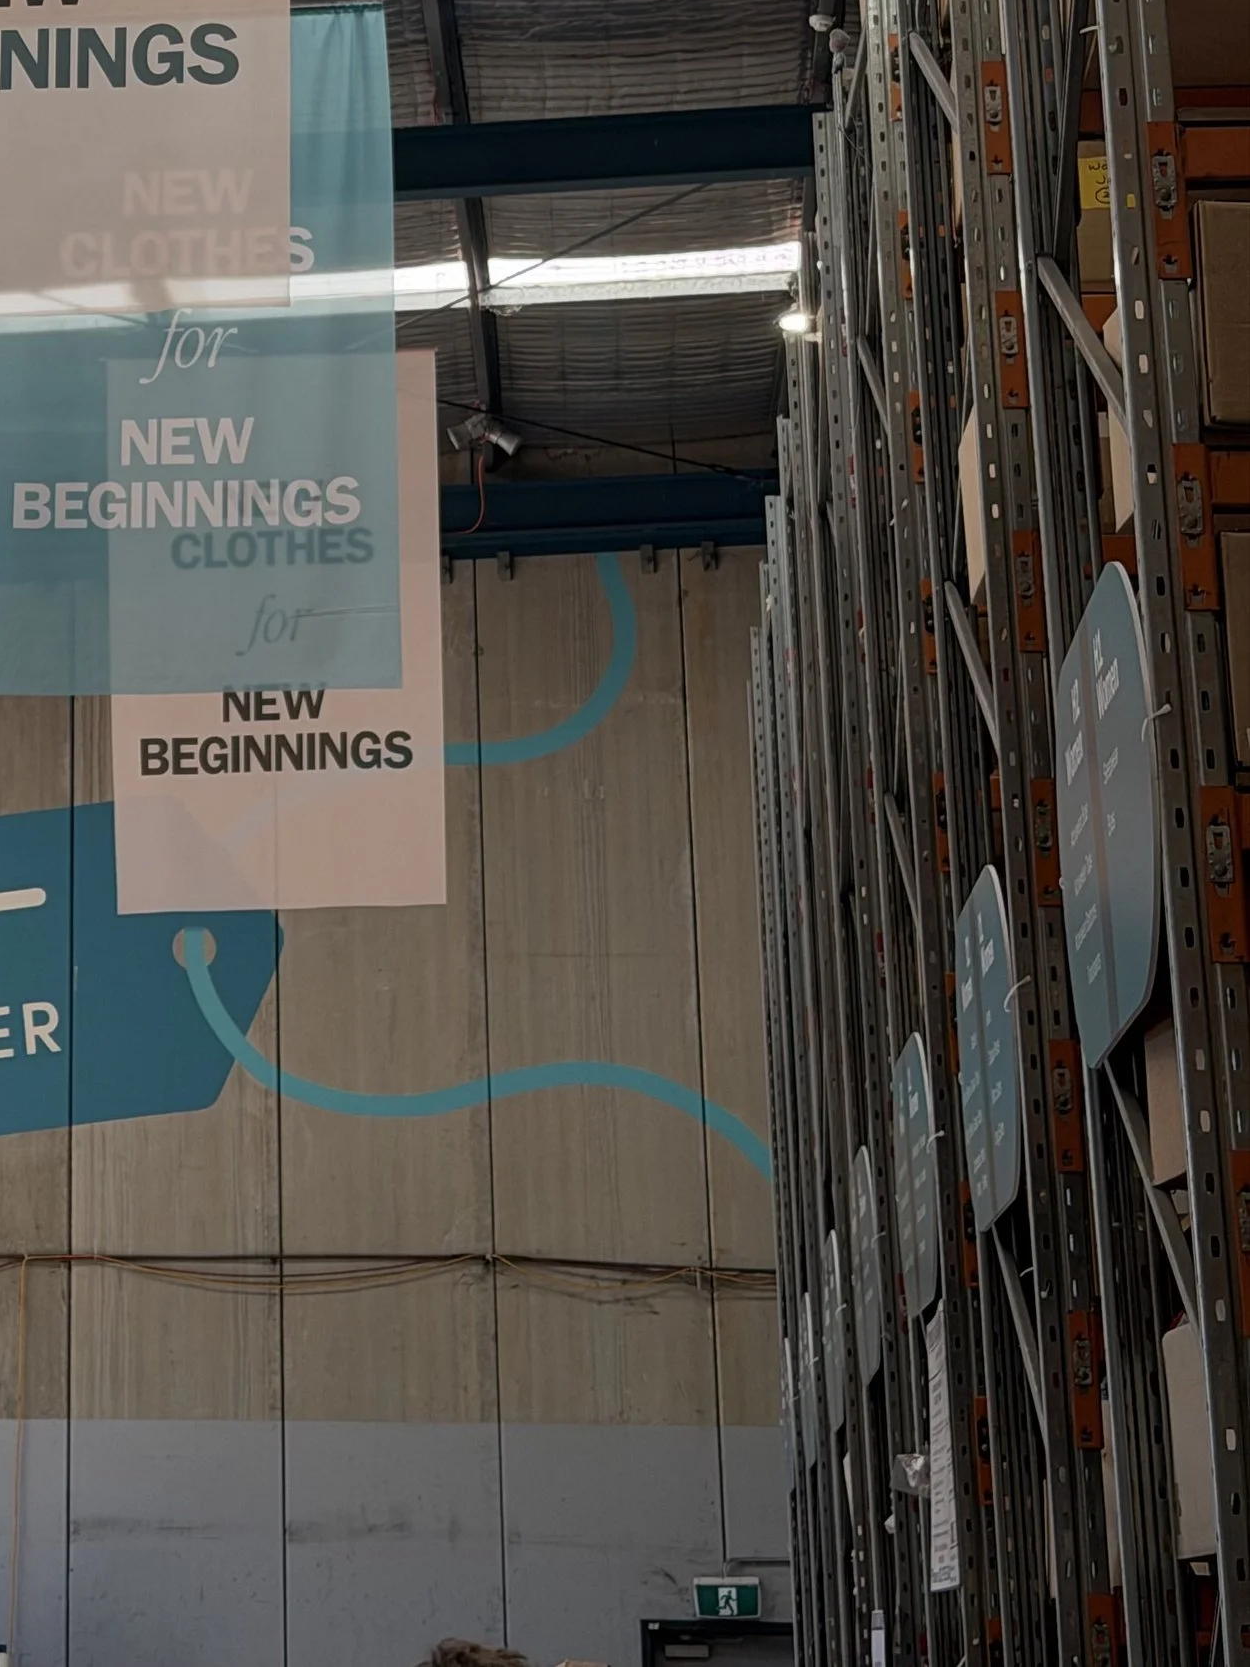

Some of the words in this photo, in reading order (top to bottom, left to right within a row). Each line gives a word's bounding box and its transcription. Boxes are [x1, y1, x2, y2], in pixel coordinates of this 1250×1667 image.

[122, 168, 254, 216] NEW
[60, 226, 315, 278] CLOTHES
[139, 307, 238, 384] for
[121, 417, 254, 466] NEW
[12, 476, 362, 529] BEGINNINGS
[170, 528, 375, 569] CLOTHES
[234, 594, 314, 657] for
[223, 683, 326, 722] NEW
[140, 730, 413, 776] BEGINNINGS
